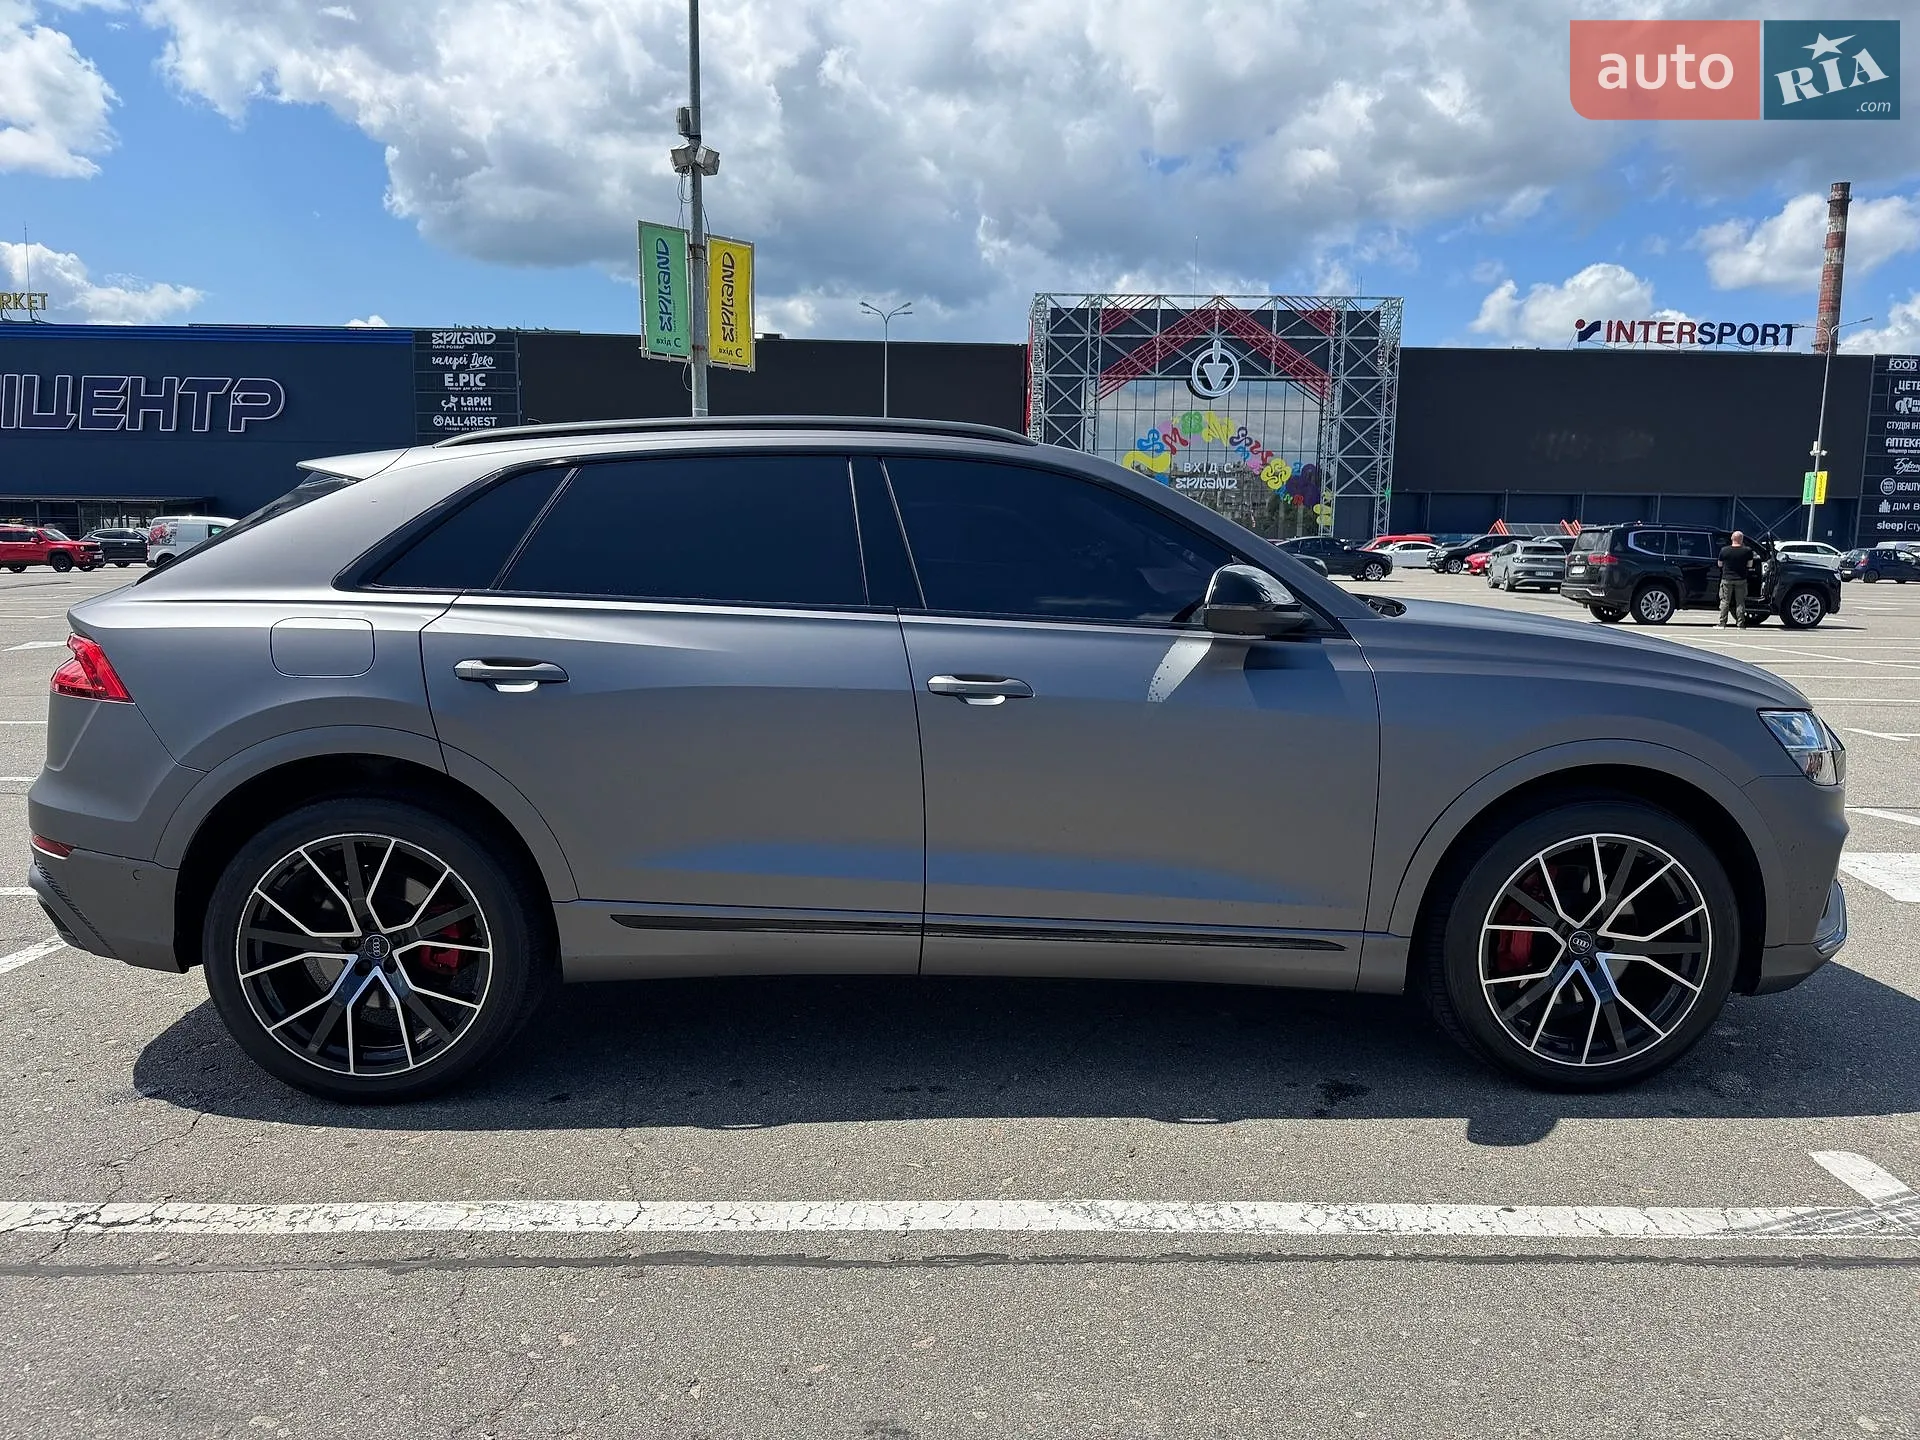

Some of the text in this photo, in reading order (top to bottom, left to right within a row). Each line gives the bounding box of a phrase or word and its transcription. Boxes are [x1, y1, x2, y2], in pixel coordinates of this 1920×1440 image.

[1605, 320, 1795, 346] INTERSPORT
[1889, 358, 1917, 369] FOOD
[444, 373, 486, 387] E.PIC
[0, 374, 285, 433] ІЦЕНТР
[444, 416, 498, 426] ALL4REST
[1184, 462, 1218, 474] ВХІД
